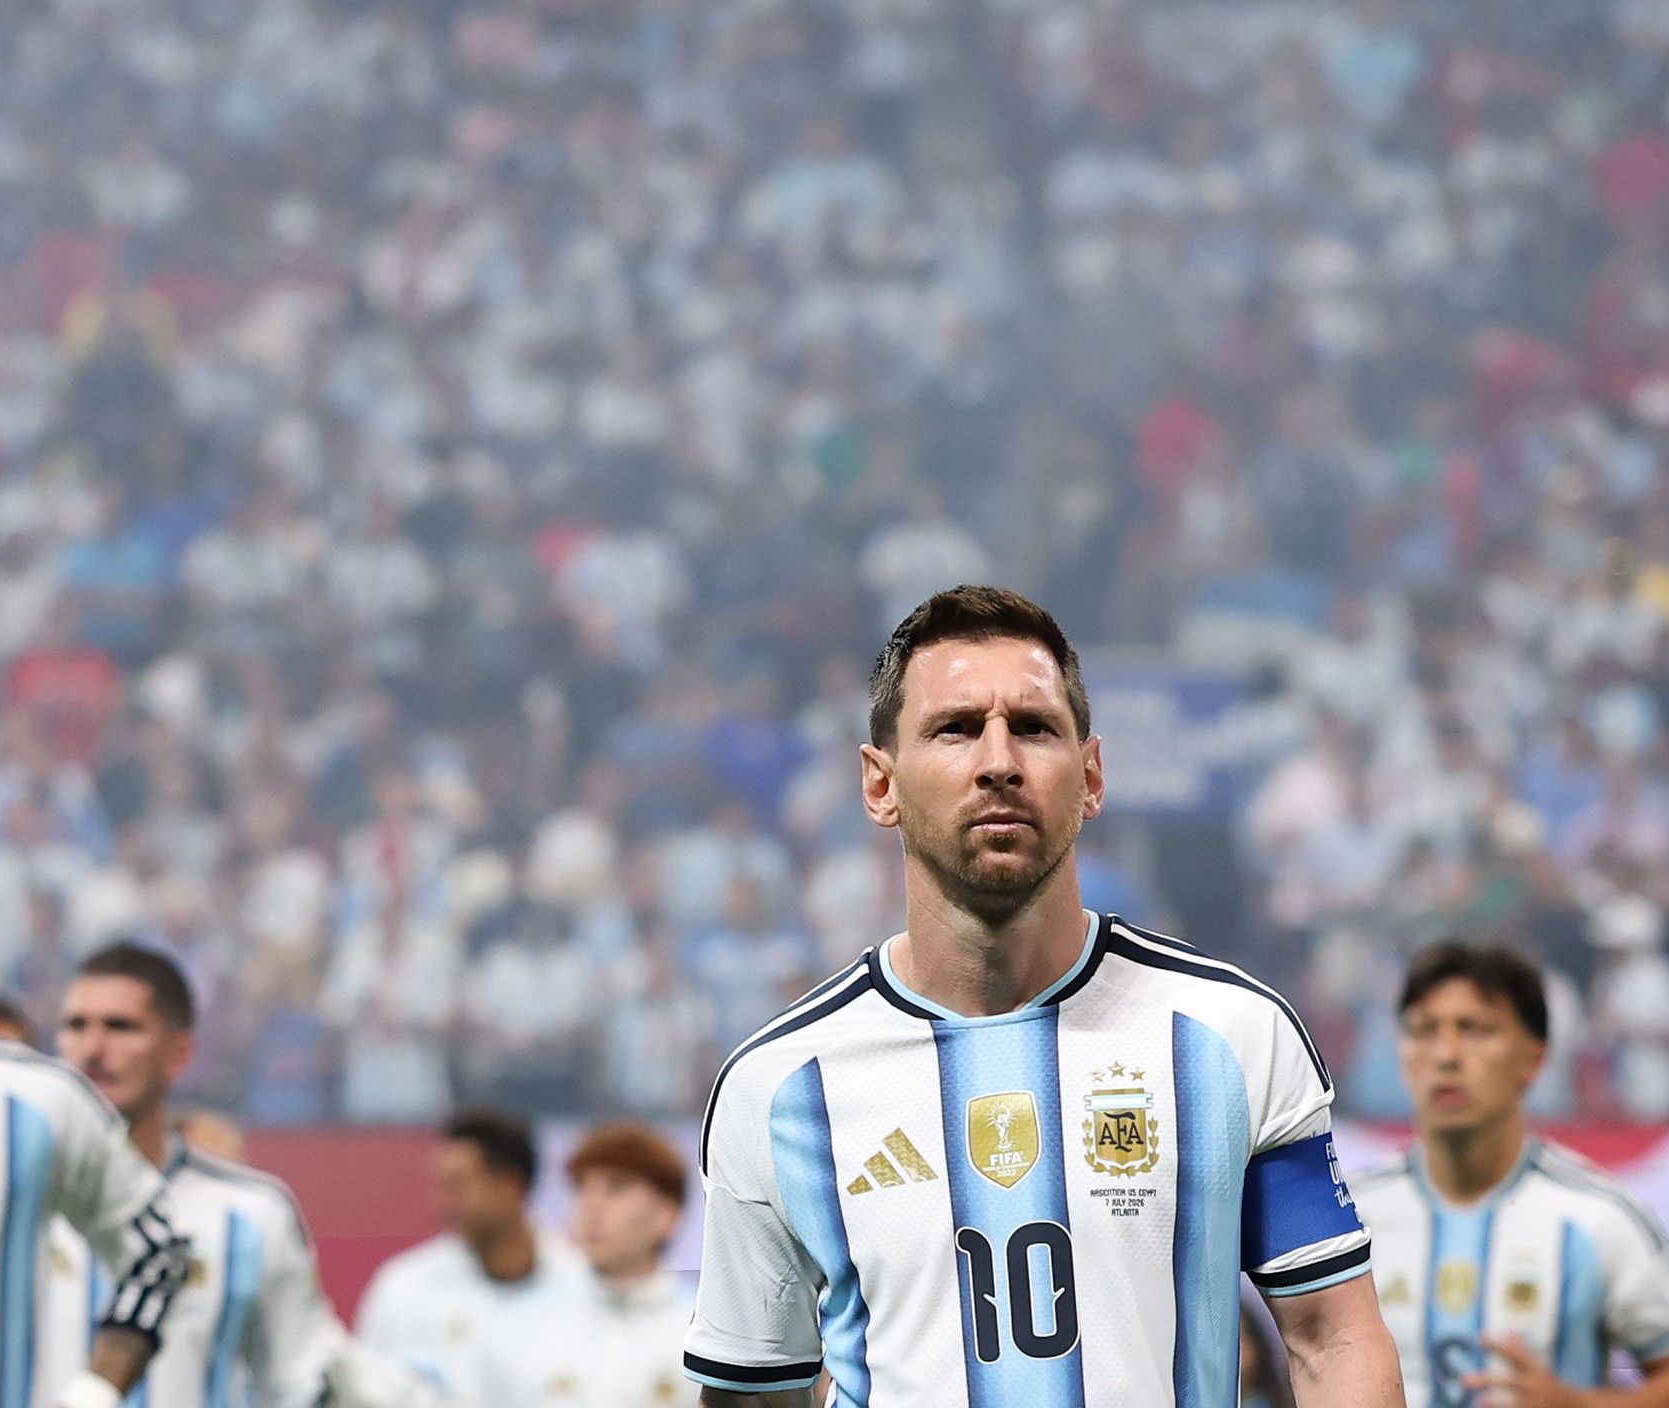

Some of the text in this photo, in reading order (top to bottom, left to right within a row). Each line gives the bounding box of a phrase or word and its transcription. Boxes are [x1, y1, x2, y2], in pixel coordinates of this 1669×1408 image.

[1098, 1111, 1144, 1152] AFA
[989, 1152, 1022, 1167] FIFA
[1112, 1198, 1126, 1207] JULY
[1128, 1198, 1145, 1207] 2026
[1111, 1208, 1139, 1217] ATLANTA
[957, 1221, 1079, 1363] 10
